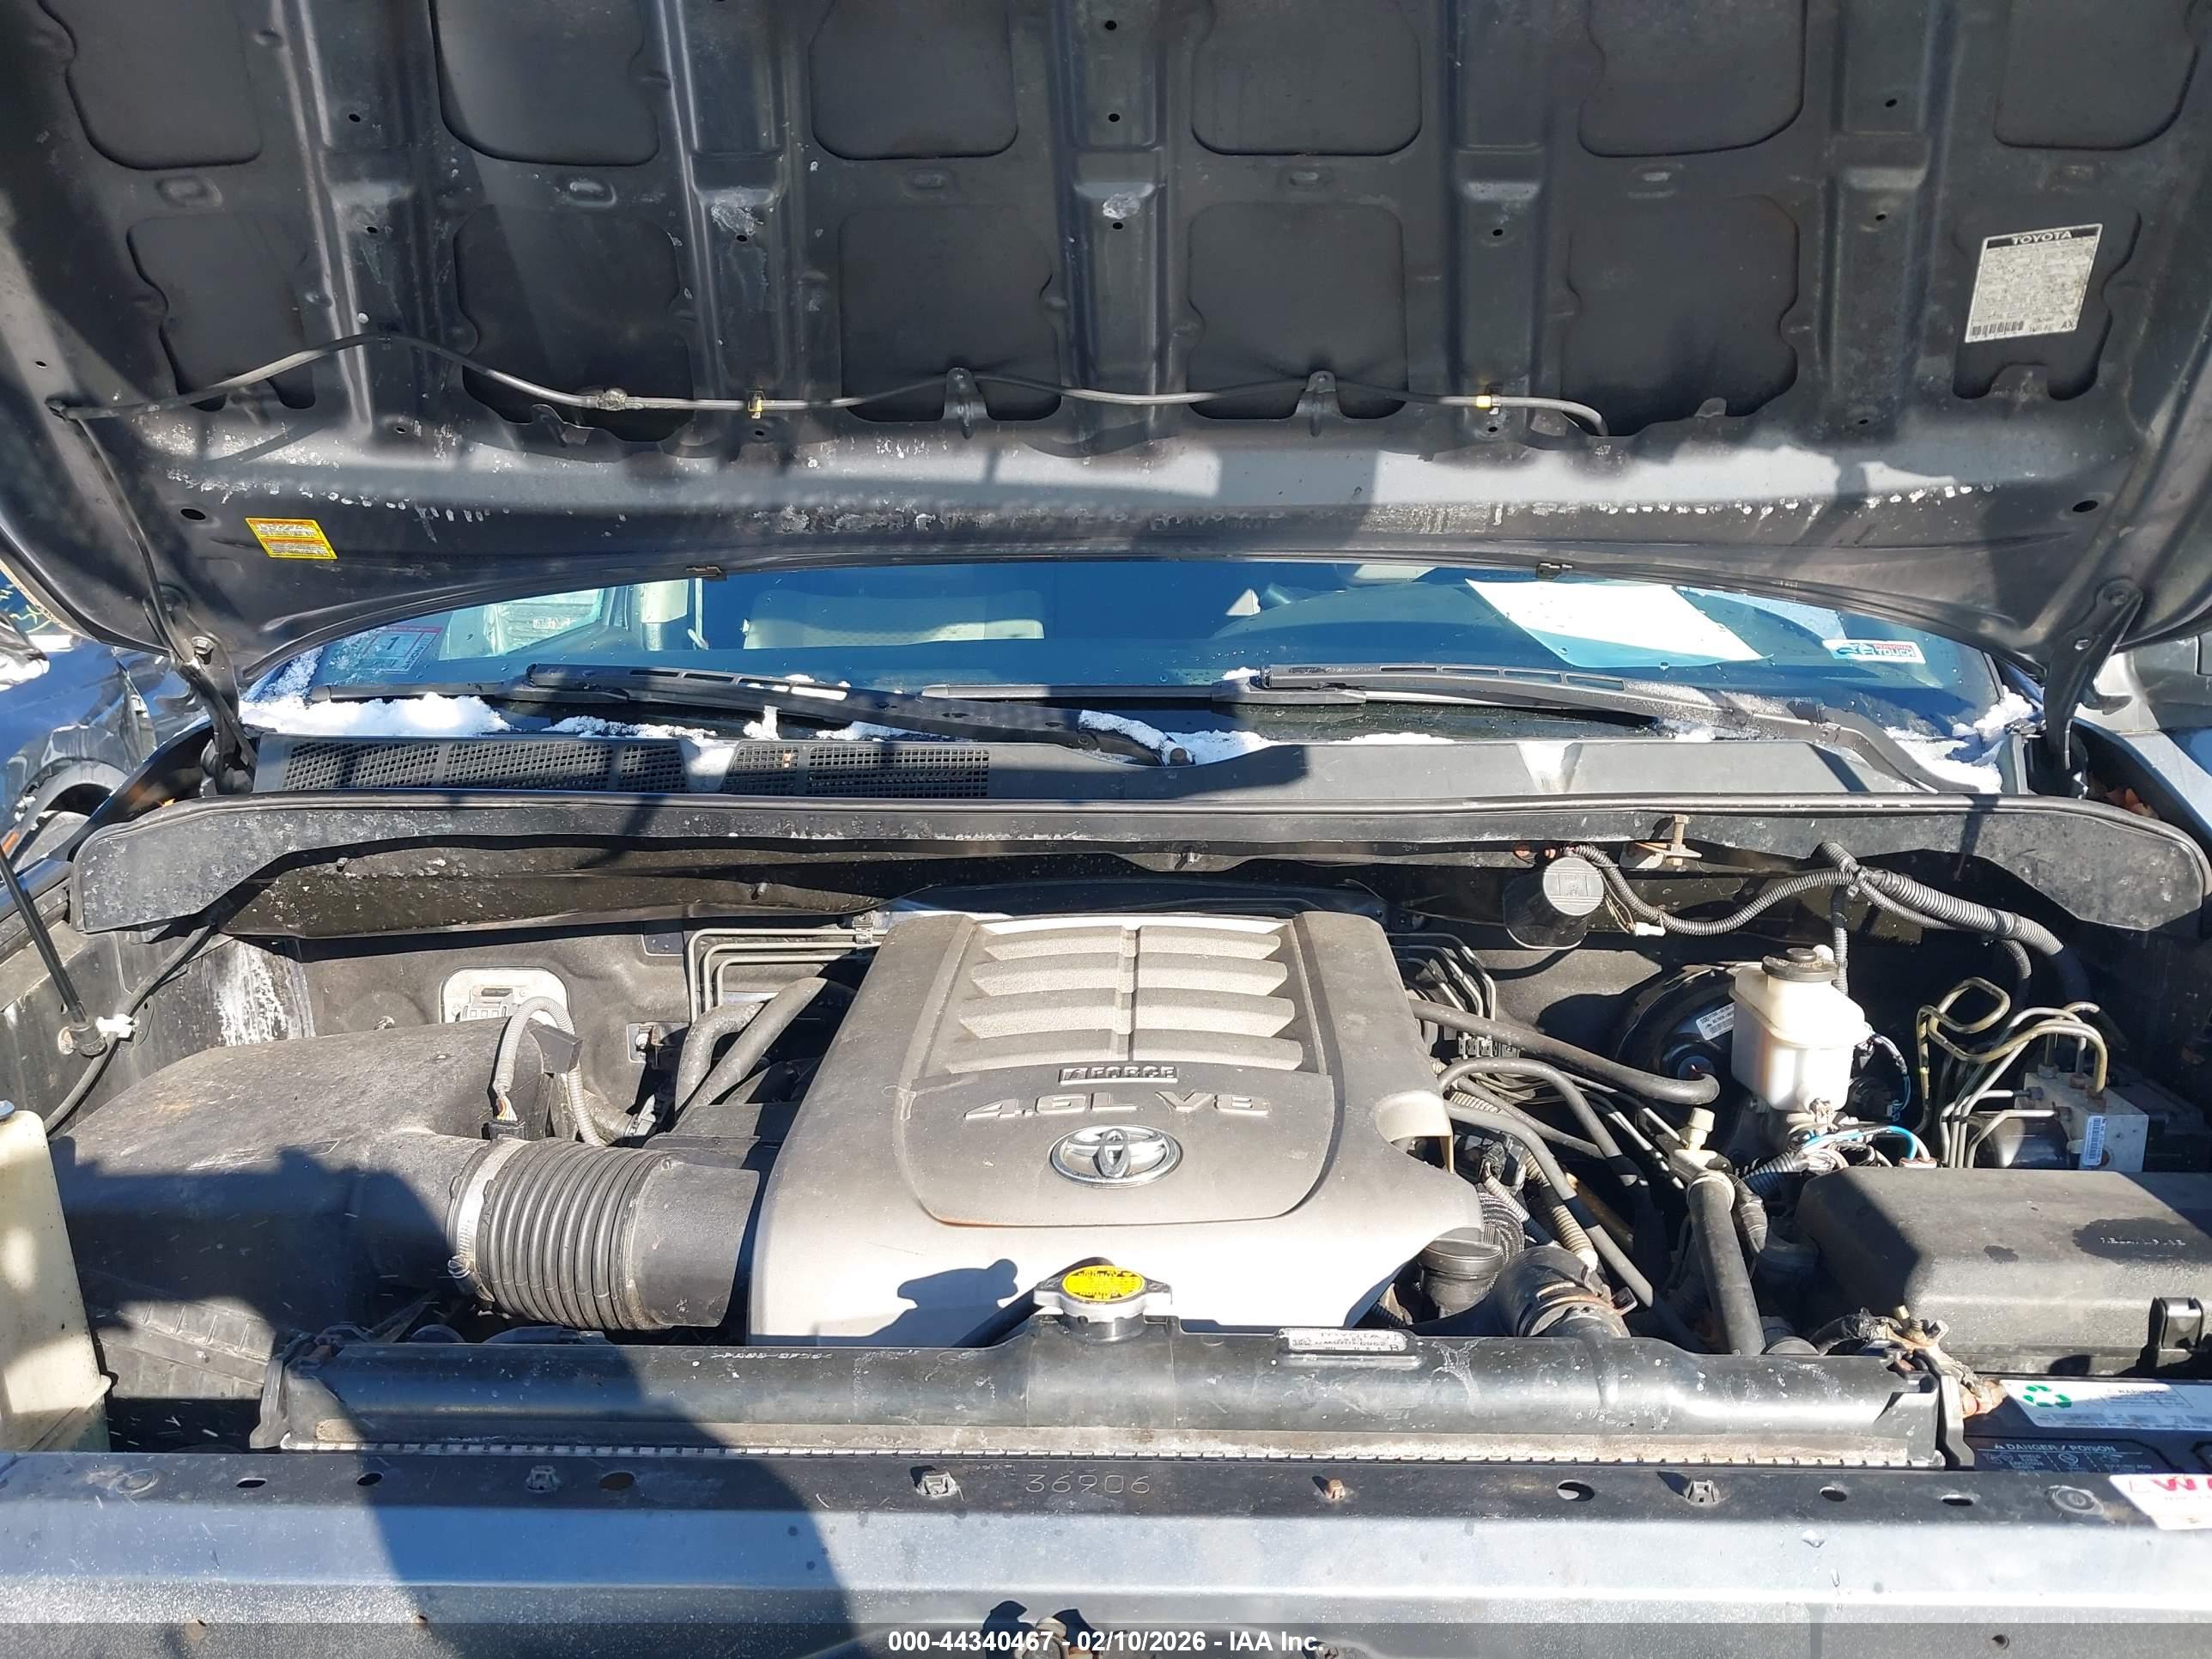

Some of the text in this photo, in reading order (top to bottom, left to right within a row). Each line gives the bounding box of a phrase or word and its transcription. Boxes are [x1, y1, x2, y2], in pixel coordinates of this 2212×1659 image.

[2012, 230, 2073, 245] TOYOTA
[1875, 648, 1915, 657] TOUCH
[964, 1091, 1270, 1120] 4.6L V8
[1025, 1474, 1150, 1493] 36906
